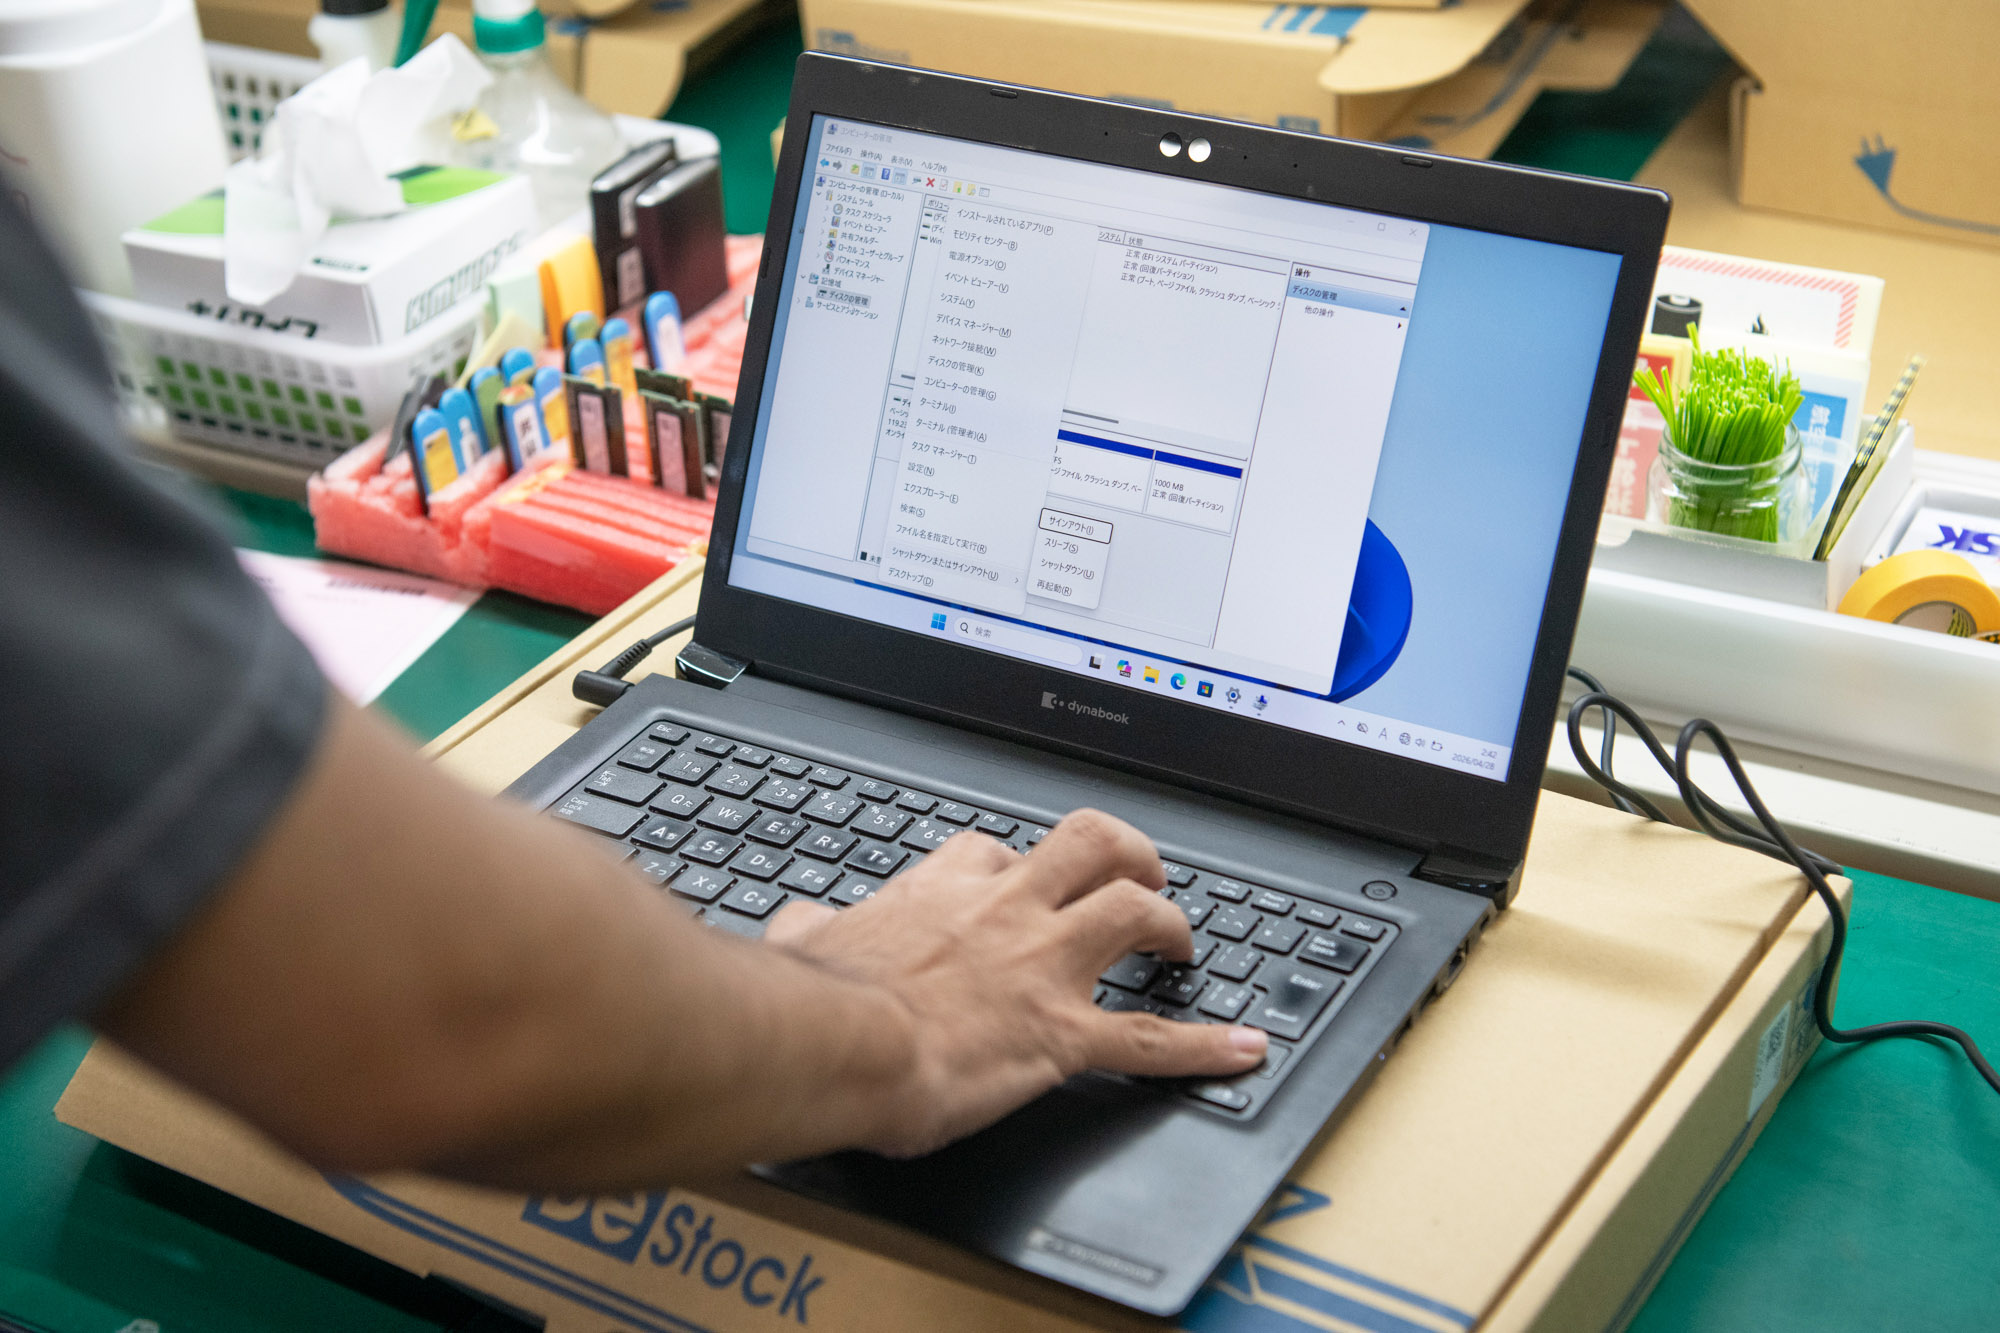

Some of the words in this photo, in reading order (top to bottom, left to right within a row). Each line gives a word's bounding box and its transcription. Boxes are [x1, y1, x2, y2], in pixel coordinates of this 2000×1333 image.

[860, 150, 883, 161] 操作(A)
[891, 155, 913, 167] 表示(V)
[921, 161, 947, 173] ヘルプ(H)
[928, 200, 950, 210] ボリュー
[957, 208, 1054, 236] インストールされているアプリ(P)
[840, 232, 879, 245] 共有フォルダー
[1099, 231, 1121, 243] システム
[1128, 236, 1143, 246] 状態
[836, 256, 870, 269] パフォーマンス
[949, 251, 1007, 271] 電源オプション(O)
[1294, 268, 1311, 278] 操作
[821, 277, 842, 288] 記憶域
[829, 291, 869, 306] ディスクの管理
[1292, 285, 1338, 301] ディスクの管理
[940, 293, 975, 309] システム(Y)
[1304, 306, 1335, 318] 他の操作
[931, 334, 997, 357] ネットワーク接続(W)
[927, 355, 985, 376] ディスクの管理(K)
[923, 377, 997, 401] コンピューターの管理(G)
[919, 397, 957, 415] ターミナル(I)
[907, 462, 935, 477] 設定(N)
[1154, 479, 1171, 489] 1000
[1172, 483, 1184, 491] MB
[903, 483, 959, 504] エクスプローラー(E)
[900, 503, 925, 518] 検索(S)
[1049, 516, 1094, 536] サインアウト(I)
[896, 524, 987, 554] ファイル名を指定して実行(R)
[1044, 538, 1079, 554] スリープ(S)
[892, 547, 999, 581] シャットダウンまたはサインアウト(U)
[1041, 558, 1095, 580] シャットダウン(U)
[888, 567, 934, 587] デスクトップ(D)
[1036, 579, 1073, 597] 再起動(R)
[975, 626, 992, 639] 検索
[1067, 700, 1129, 725] dynabook
[740, 747, 753, 755] F2
[778, 757, 790, 765] F3
[864, 781, 877, 789] F5
[570, 796, 589, 806] Caps
[903, 791, 916, 800] F6
[564, 802, 583, 811] Lock
[943, 803, 958, 811] F7
[983, 814, 997, 822] F8
